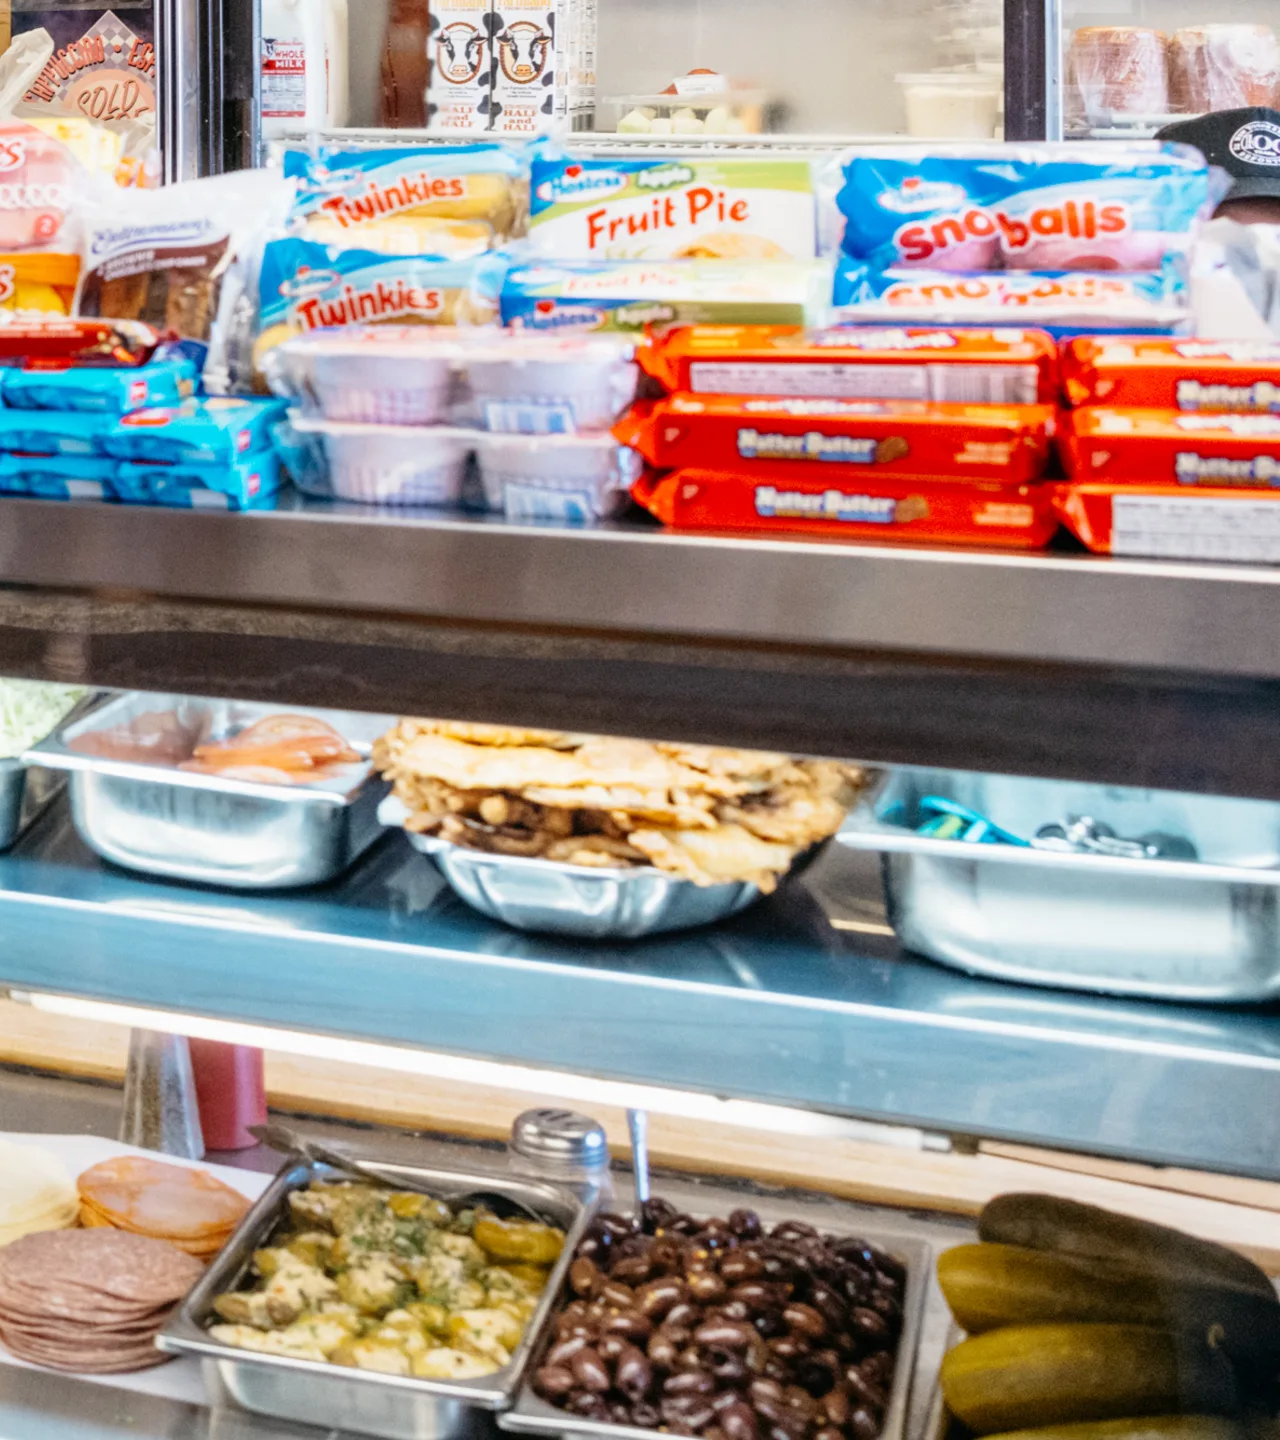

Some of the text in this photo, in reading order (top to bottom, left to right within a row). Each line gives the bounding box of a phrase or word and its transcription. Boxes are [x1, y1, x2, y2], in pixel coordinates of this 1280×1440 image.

[322, 173, 464, 231] Twinkies
[586, 188, 750, 244] Fruit Pie
